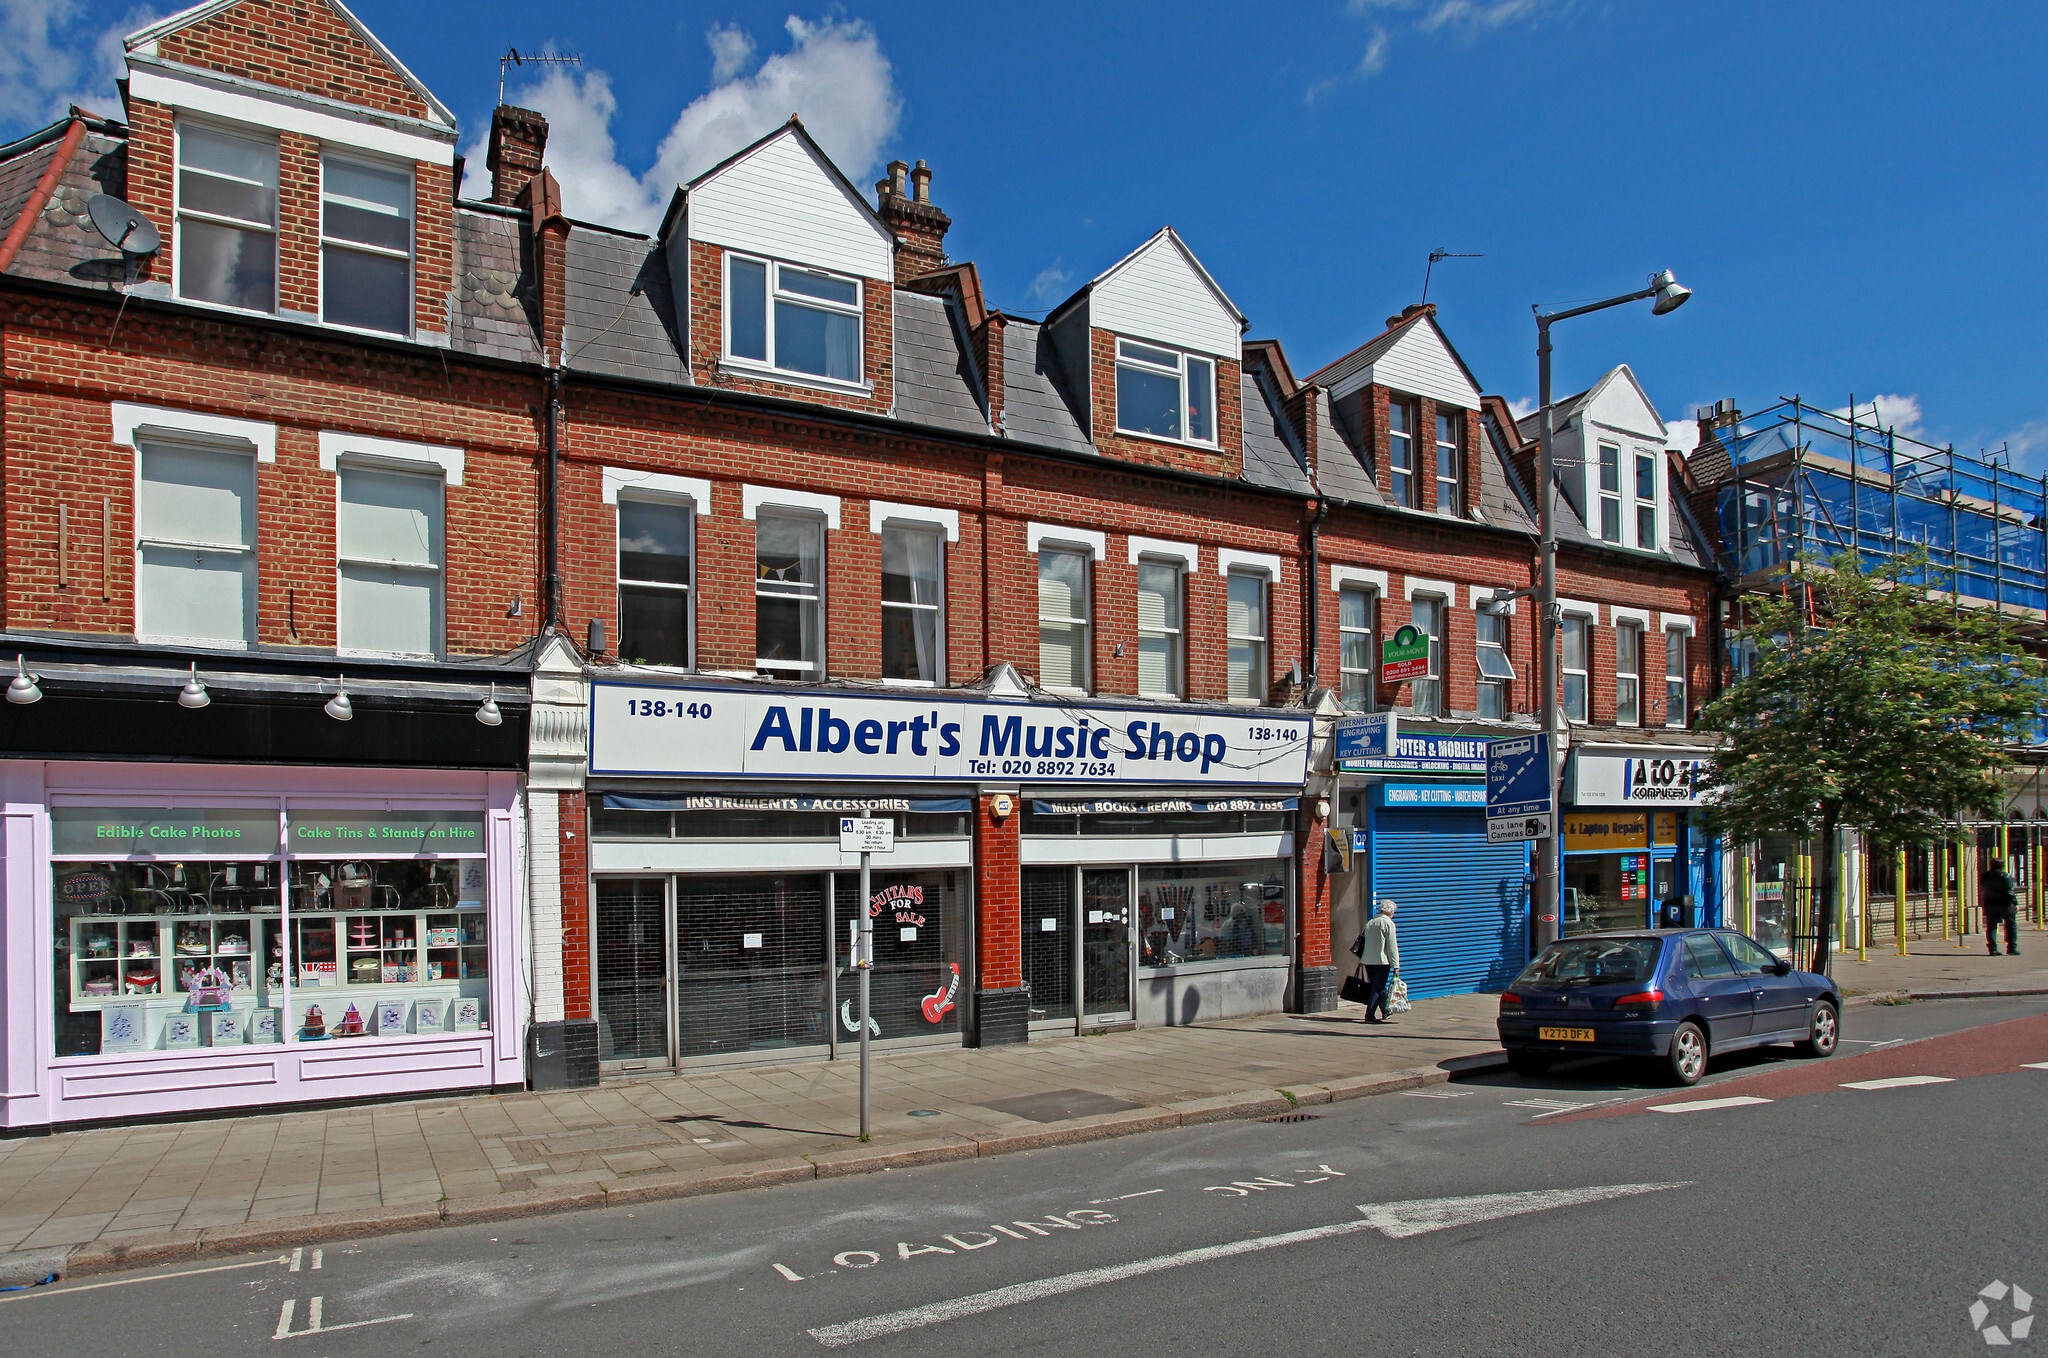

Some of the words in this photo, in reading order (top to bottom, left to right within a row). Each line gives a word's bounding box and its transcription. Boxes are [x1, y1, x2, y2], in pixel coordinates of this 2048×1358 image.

[1388, 650, 1405, 658] YOUR
[1406, 647, 1424, 655] MOVE
[628, 699, 712, 719] 138-140
[1338, 717, 1368, 729] INTERNET
[1248, 727, 1298, 741] 138-140
[1343, 726, 1380, 737] ENGRAVING
[750, 705, 961, 757] Albert's
[979, 714, 1111, 760] Music
[1124, 720, 1226, 774] Shop
[1340, 749, 1352, 757] KEY
[1353, 747, 1382, 756] CUTTING
[1429, 741, 1438, 757] &
[1438, 741, 1475, 758] MOBILE
[969, 760, 996, 774] Tel:
[1002, 761, 1032, 775] 020
[1036, 761, 1075, 776] 8892
[1079, 762, 1116, 777] 7634
[1345, 760, 1365, 768] MOBILE
[1366, 760, 1383, 768] PHONE
[1384, 760, 1418, 770] ACCESSORIES
[1422, 762, 1449, 770] UNLOCKING
[1453, 763, 1470, 771] DIGITAL
[1633, 759, 1647, 785] A
[1491, 774, 1505, 782] taxi
[1389, 790, 1417, 801] ENGRAVING
[1421, 790, 1430, 801] KEY
[1431, 790, 1451, 801] CUTTING
[1455, 790, 1471, 802] WATCH
[1632, 787, 1689, 800] COMPUTERS
[686, 796, 798, 809] INSTRUMENTS
[812, 799, 910, 810] ACCESSORIES
[1051, 802, 1090, 813] MUSIC
[1094, 801, 1137, 813] BOOKS
[1147, 801, 1193, 812] REPAIRS
[1207, 801, 1227, 811] 020
[1230, 800, 1256, 811] 8892
[1508, 806, 1520, 814] any
[97, 825, 145, 838] Edible
[150, 826, 187, 838] Cake
[192, 826, 241, 838] Photos
[297, 827, 332, 838] Cake
[336, 827, 363, 838] Tins
[368, 827, 378, 838] &
[382, 827, 425, 838] Stands
[429, 830, 446, 838] on
[449, 827, 475, 838] Hire
[1491, 830, 1524, 839] Cameras
[1569, 823, 1576, 834] &
[1579, 822, 1609, 836] Laptop
[1612, 822, 1645, 836] Repairs
[64, 880, 110, 894] OPEN
[869, 884, 924, 917] GUITARS
[890, 899, 911, 910] FOR
[895, 911, 926, 927] SALE
[1670, 906, 1679, 919] P
[1543, 1028, 1568, 1039] Y273
[1571, 1029, 1590, 1040] DFX
[1203, 1165, 1346, 1197] ONLY
[772, 1210, 1120, 1281] LOADING
